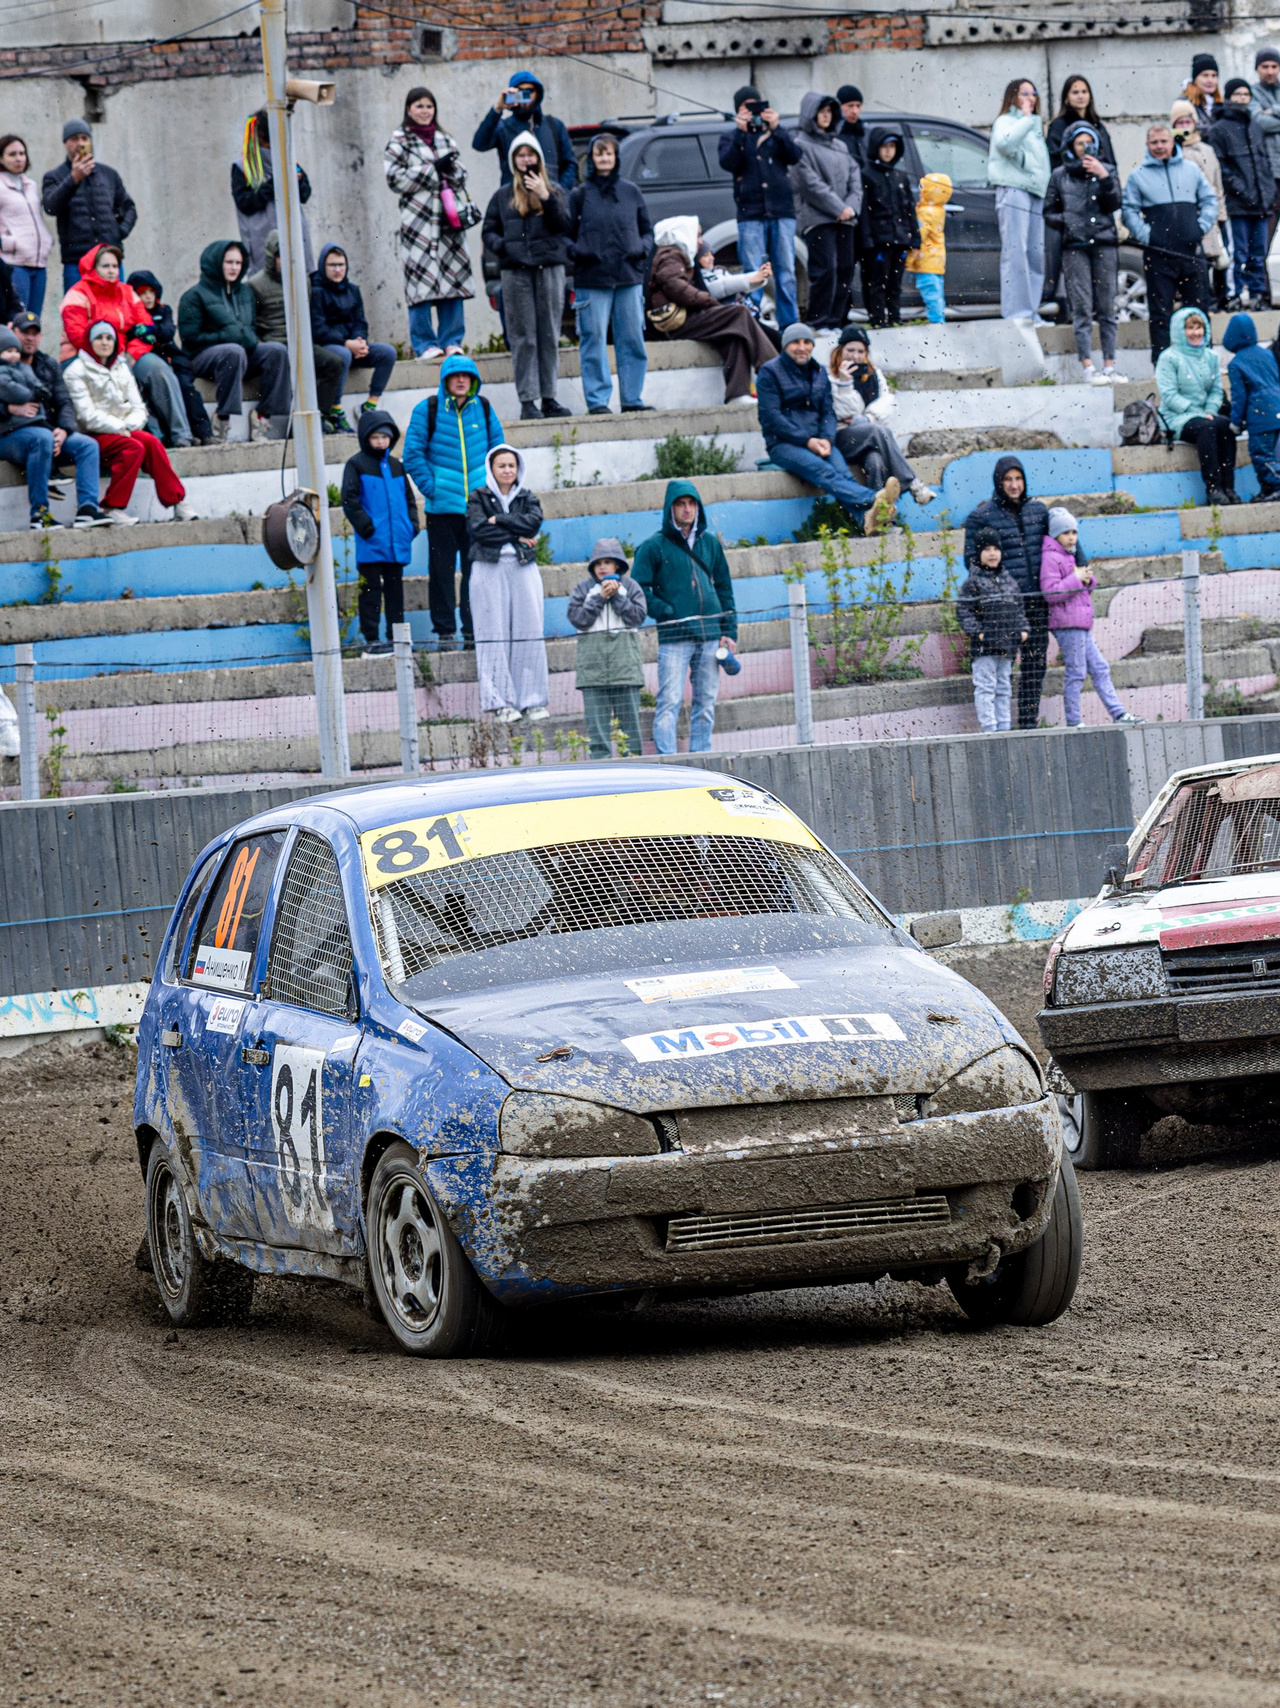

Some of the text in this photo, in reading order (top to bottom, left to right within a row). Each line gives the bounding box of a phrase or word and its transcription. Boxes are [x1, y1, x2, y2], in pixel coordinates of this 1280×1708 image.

[371, 817, 464, 874] 81
[215, 846, 261, 949] 81
[204, 955, 238, 981] Анищенко
[650, 1020, 808, 1054] Mobil
[275, 1064, 328, 1211] 81
